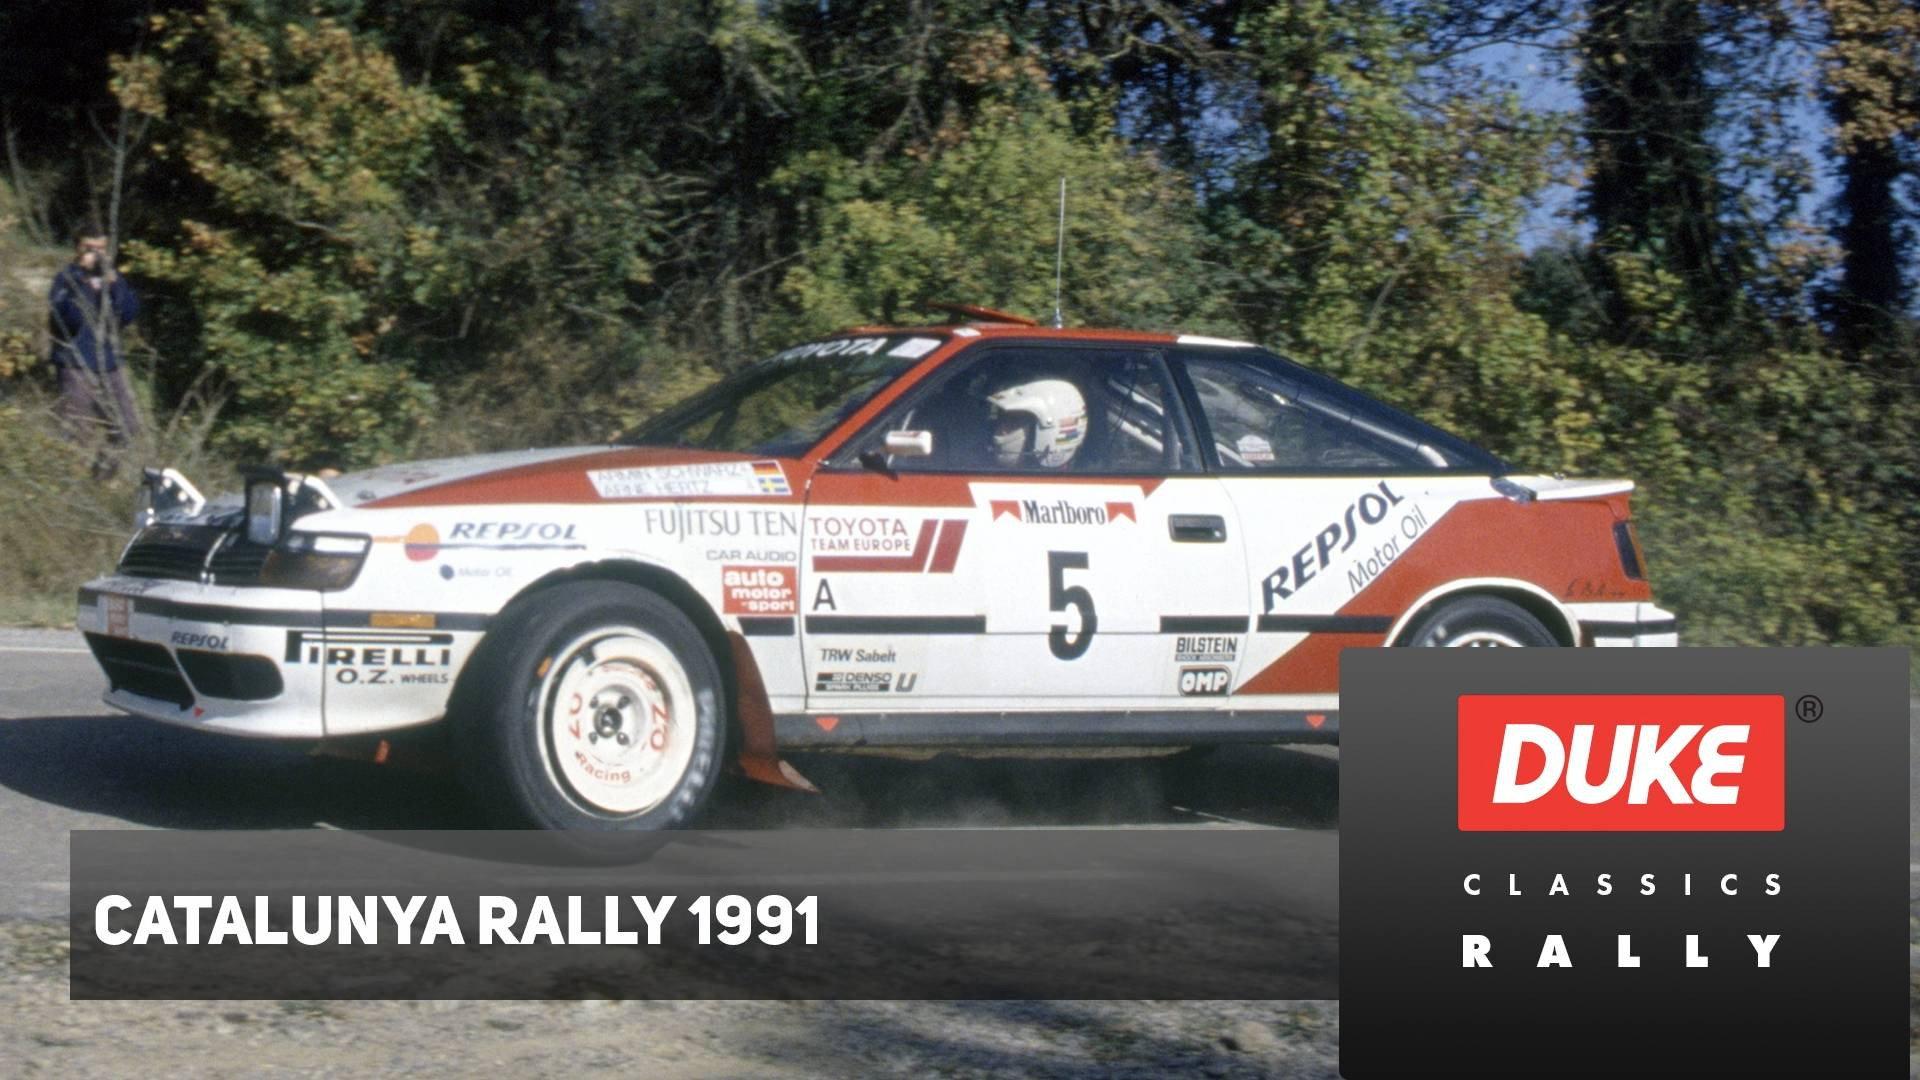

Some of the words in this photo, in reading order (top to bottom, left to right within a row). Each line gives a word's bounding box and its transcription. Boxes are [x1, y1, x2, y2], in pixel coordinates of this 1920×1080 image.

[1024, 499, 1106, 525] Marlboro
[450, 521, 577, 541] REPSOL
[645, 503, 741, 543] FUJITSU
[748, 511, 798, 536] TEN
[809, 517, 908, 537] TOYOTA
[811, 539, 850, 551] TEAM
[854, 539, 910, 551] EUROPE
[1262, 480, 1405, 615] REPSOL
[1347, 536, 1400, 594] Motor
[1401, 503, 1428, 540] Oil
[706, 550, 742, 561] CAR
[745, 551, 797, 562] AUDIO
[724, 569, 785, 587] auto
[731, 586, 793, 600] motor
[812, 578, 837, 612] A
[1047, 550, 1099, 661] 5
[170, 631, 230, 650] REPSOL
[285, 630, 454, 666] PIRELLI
[1176, 637, 1238, 653] BILSTEIN
[820, 648, 853, 661] TRW
[855, 648, 896, 662] Sabelt
[401, 673, 449, 685] WHEELS
[845, 672, 893, 683] DENSO
[1181, 671, 1229, 692] OMP
[577, 754, 632, 784] Racing
